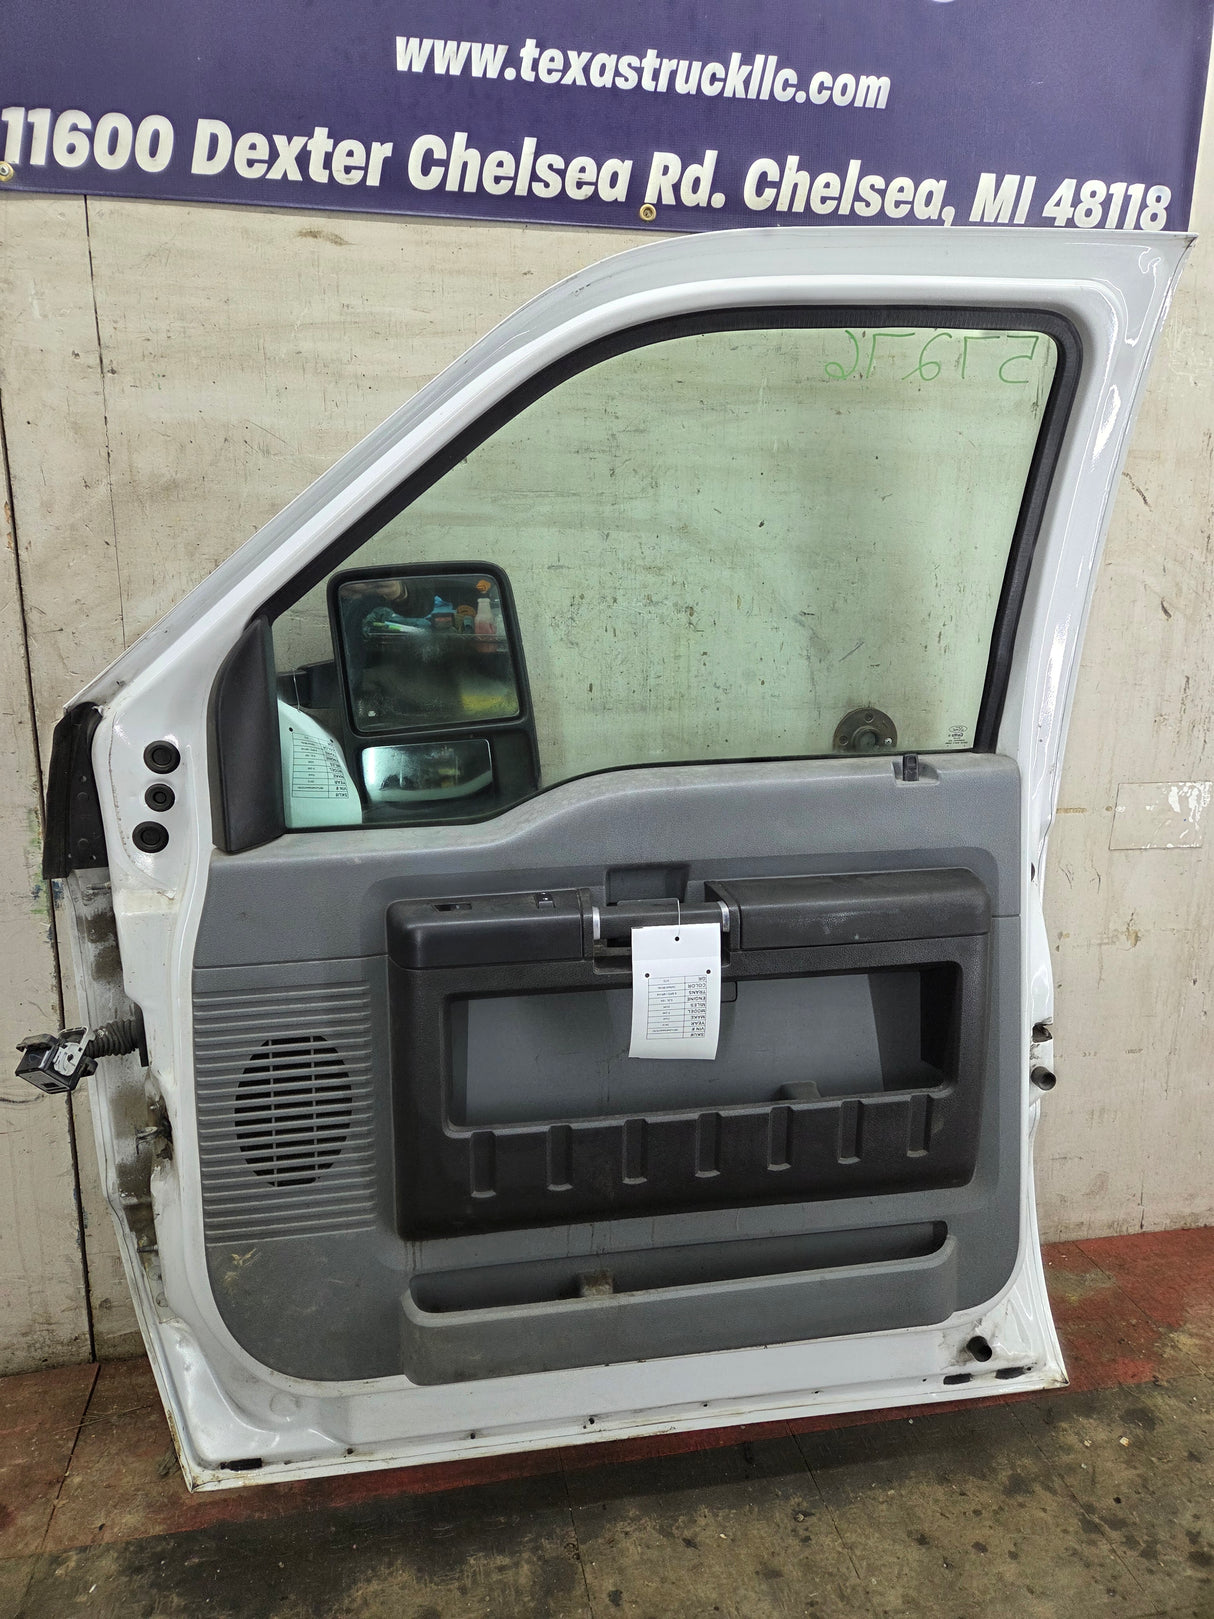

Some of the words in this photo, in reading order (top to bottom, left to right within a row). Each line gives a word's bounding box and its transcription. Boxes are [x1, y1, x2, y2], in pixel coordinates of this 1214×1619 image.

[395, 36, 890, 109] www.texastruckllc.com
[1, 107, 174, 173] 11600
[191, 119, 393, 187] Dexter
[408, 132, 634, 202] Chelsea
[643, 150, 726, 208] Rd.
[744, 155, 955, 227] Chelsea,
[969, 173, 1036, 225] MI
[1042, 178, 1172, 231] 48118
